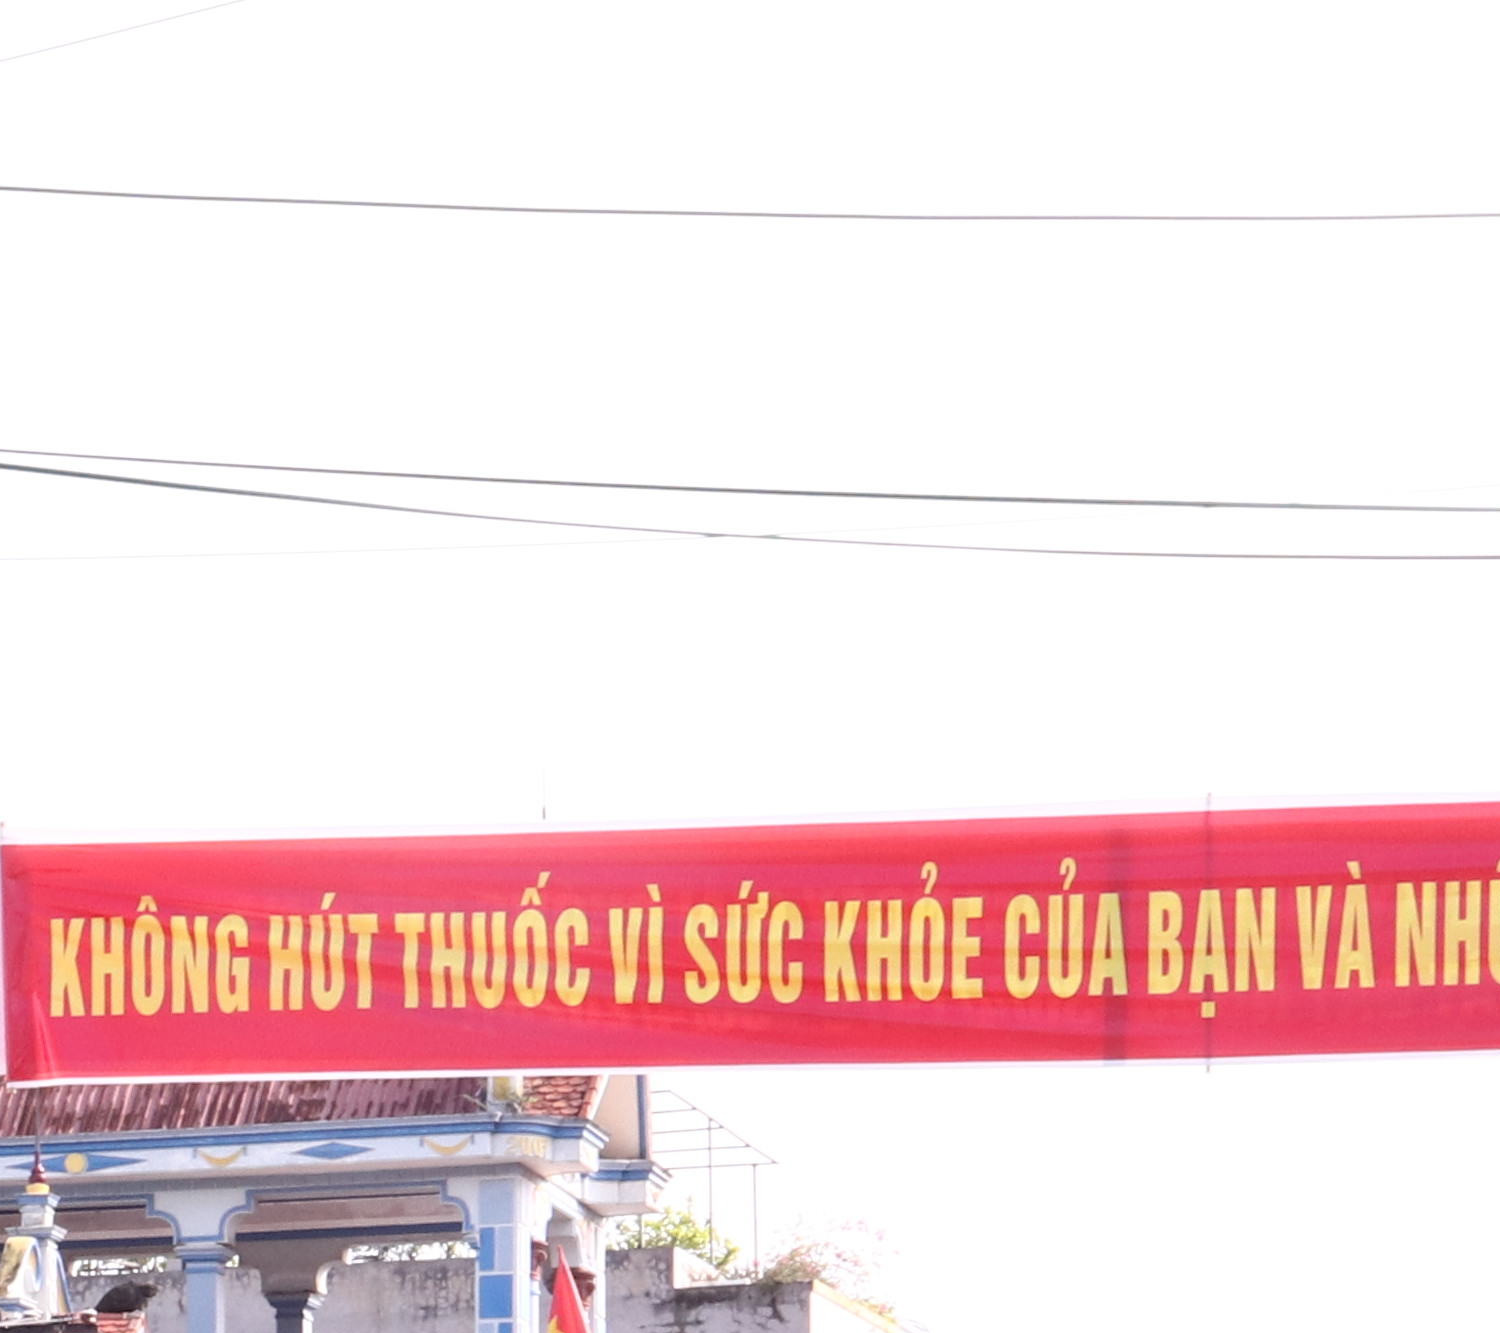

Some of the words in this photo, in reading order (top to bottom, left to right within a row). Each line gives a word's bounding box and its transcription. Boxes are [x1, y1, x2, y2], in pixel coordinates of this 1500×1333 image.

[49, 896, 250, 1018] KHÔNG
[268, 893, 379, 1011] HÚT
[395, 871, 591, 1009] THUỐC
[608, 884, 665, 1004] VÌ
[684, 880, 804, 1004] SỨC
[824, 861, 984, 1003] KHỎE
[1003, 857, 1129, 1001] CỦA
[1146, 887, 1277, 1019] BẠN
[1296, 861, 1376, 991] VÀ
